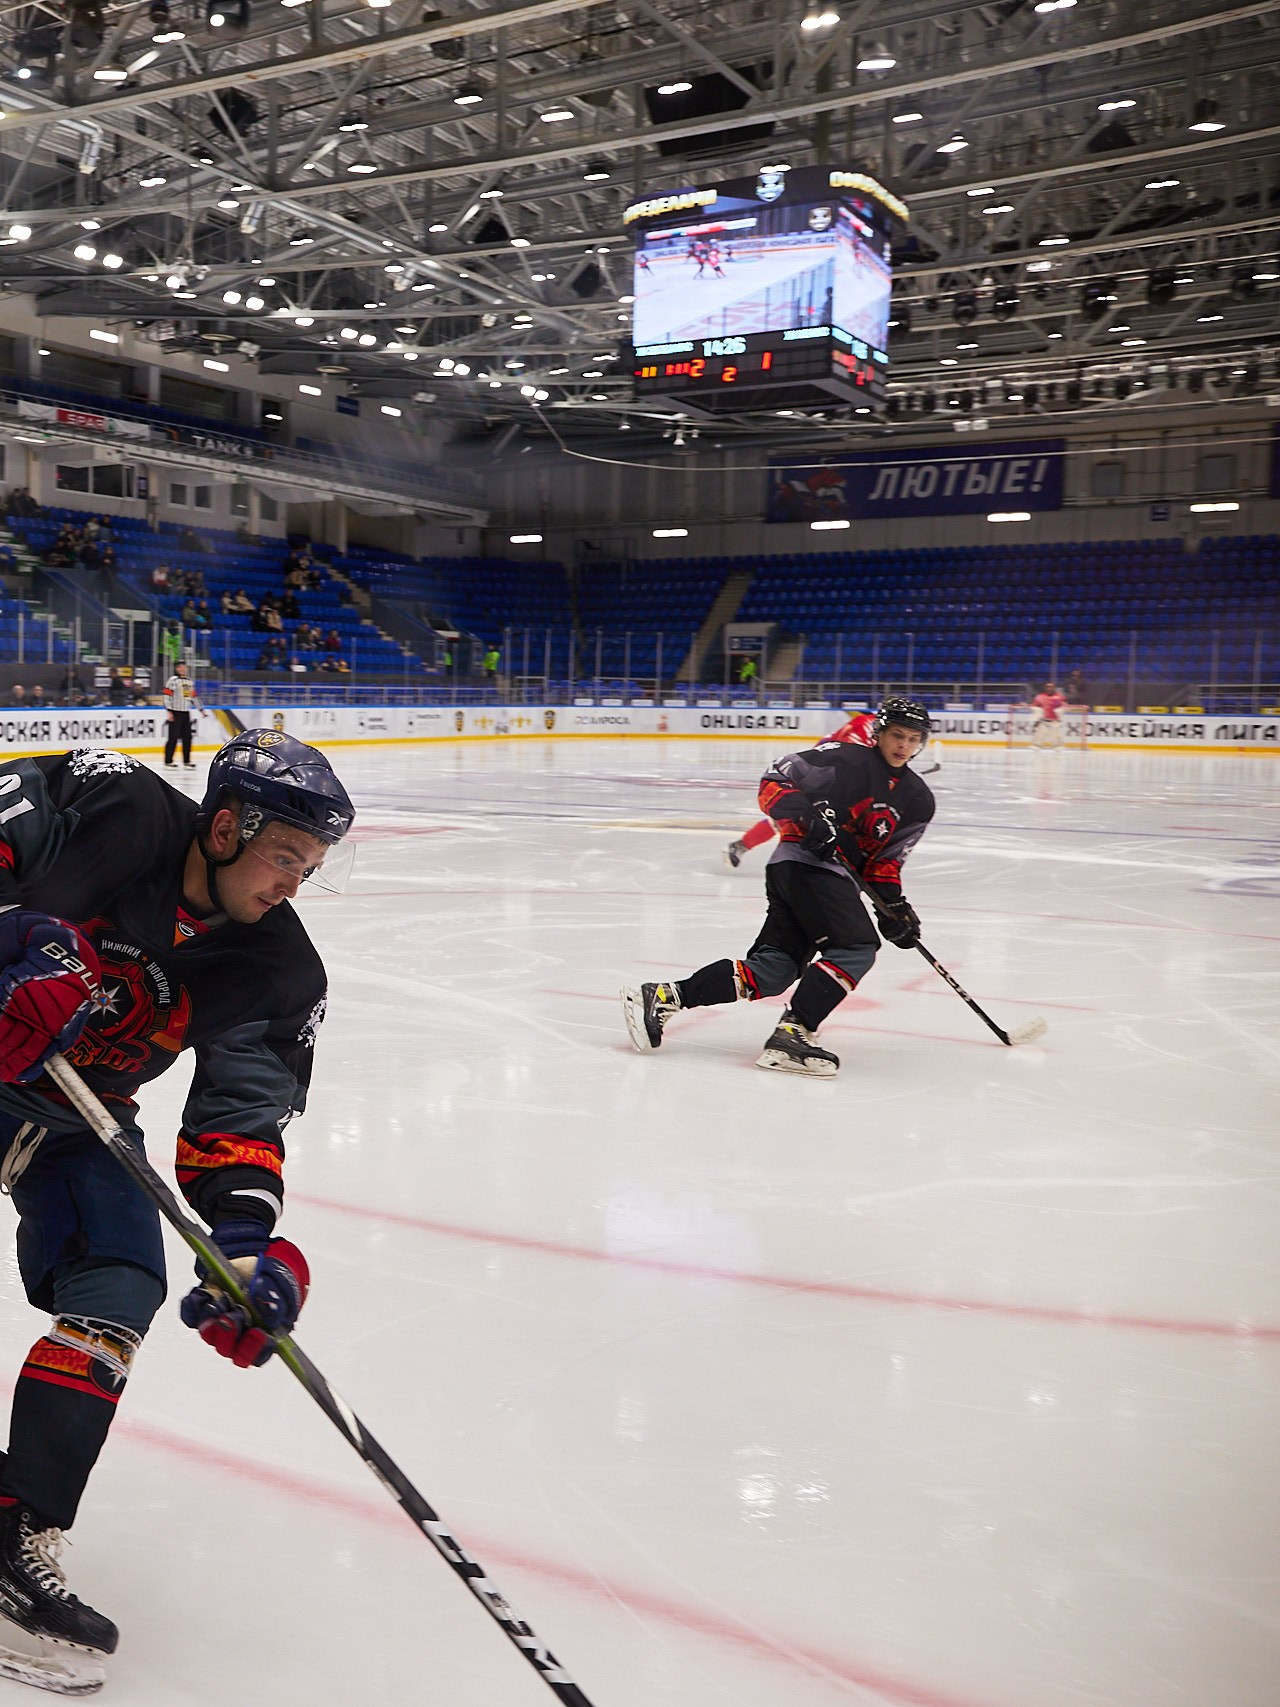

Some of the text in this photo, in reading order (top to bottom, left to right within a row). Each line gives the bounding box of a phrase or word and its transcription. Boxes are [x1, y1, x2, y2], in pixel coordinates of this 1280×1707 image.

[192, 435, 245, 456] TANK
[867, 459, 1049, 500] ЛЮТЫЕ!
[58, 714, 155, 742] ХОККЕЙНАЯ
[701, 714, 800, 730] OHLIGA.RU
[1066, 719, 1205, 740] ХОККЕЙНАЯ
[1215, 724, 1278, 741] ЛИГА
[145, 961, 171, 1004] НОВГОРОД
